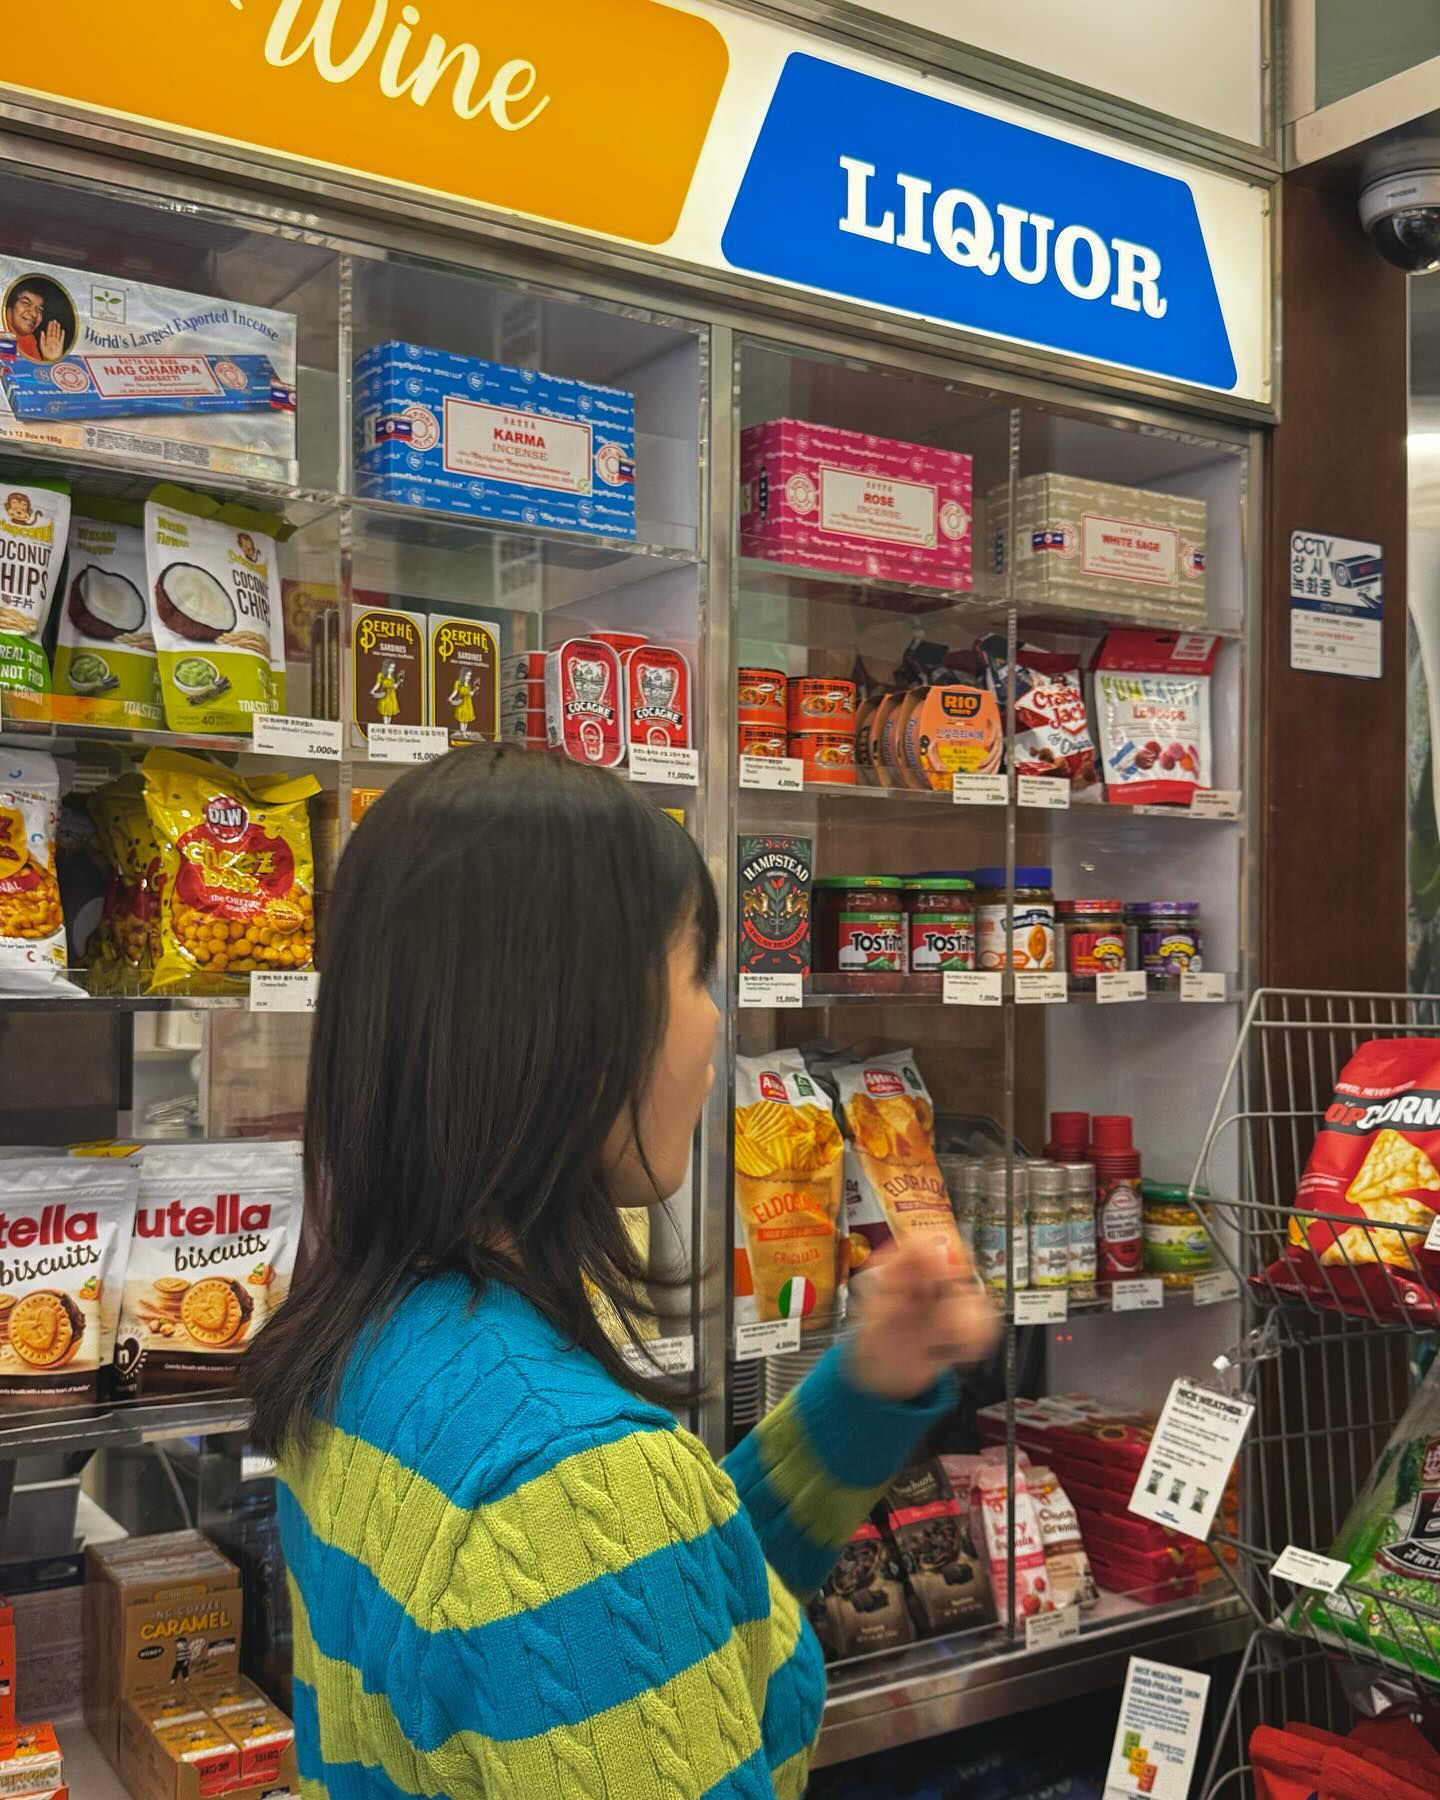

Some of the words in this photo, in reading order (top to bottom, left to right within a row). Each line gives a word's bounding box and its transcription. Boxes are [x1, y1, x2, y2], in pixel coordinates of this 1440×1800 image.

[264, 0, 550, 132] Wine
[838, 155, 1168, 320] LIQUOR
[85, 326, 129, 348] World's
[130, 324, 174, 346] Largest
[174, 308, 229, 332] Exported
[232, 310, 279, 341] Incense
[103, 365, 136, 376] NAG
[139, 364, 202, 376] CHAMPA
[493, 427, 546, 449] KARMA
[491, 442, 548, 461] INCENSE
[863, 492, 896, 508] ROSE
[1101, 534, 1133, 549] WHITE
[1135, 538, 1161, 553] SAGE
[1292, 535, 1335, 558] CCTV
[359, 619, 415, 655] BERTHE
[438, 628, 490, 663] BERTHE
[0, 664, 24, 680] NOT
[567, 701, 612, 719] COCAGNE
[944, 695, 977, 709] RIO
[635, 708, 680, 723] COCAGNE
[208, 807, 242, 827] OLW
[742, 853, 809, 882] HAMPSTEAD
[1324, 1095, 1440, 1130] OPCORN
[133, 1193, 273, 1239] utella
[174, 1233, 272, 1272] biscuits
[0, 1243, 102, 1287] biscuits
[118, 1348, 129, 1365] n
[1198, 1395, 1243, 1416] WEATHER
[140, 1610, 232, 1640] CARAMEL
